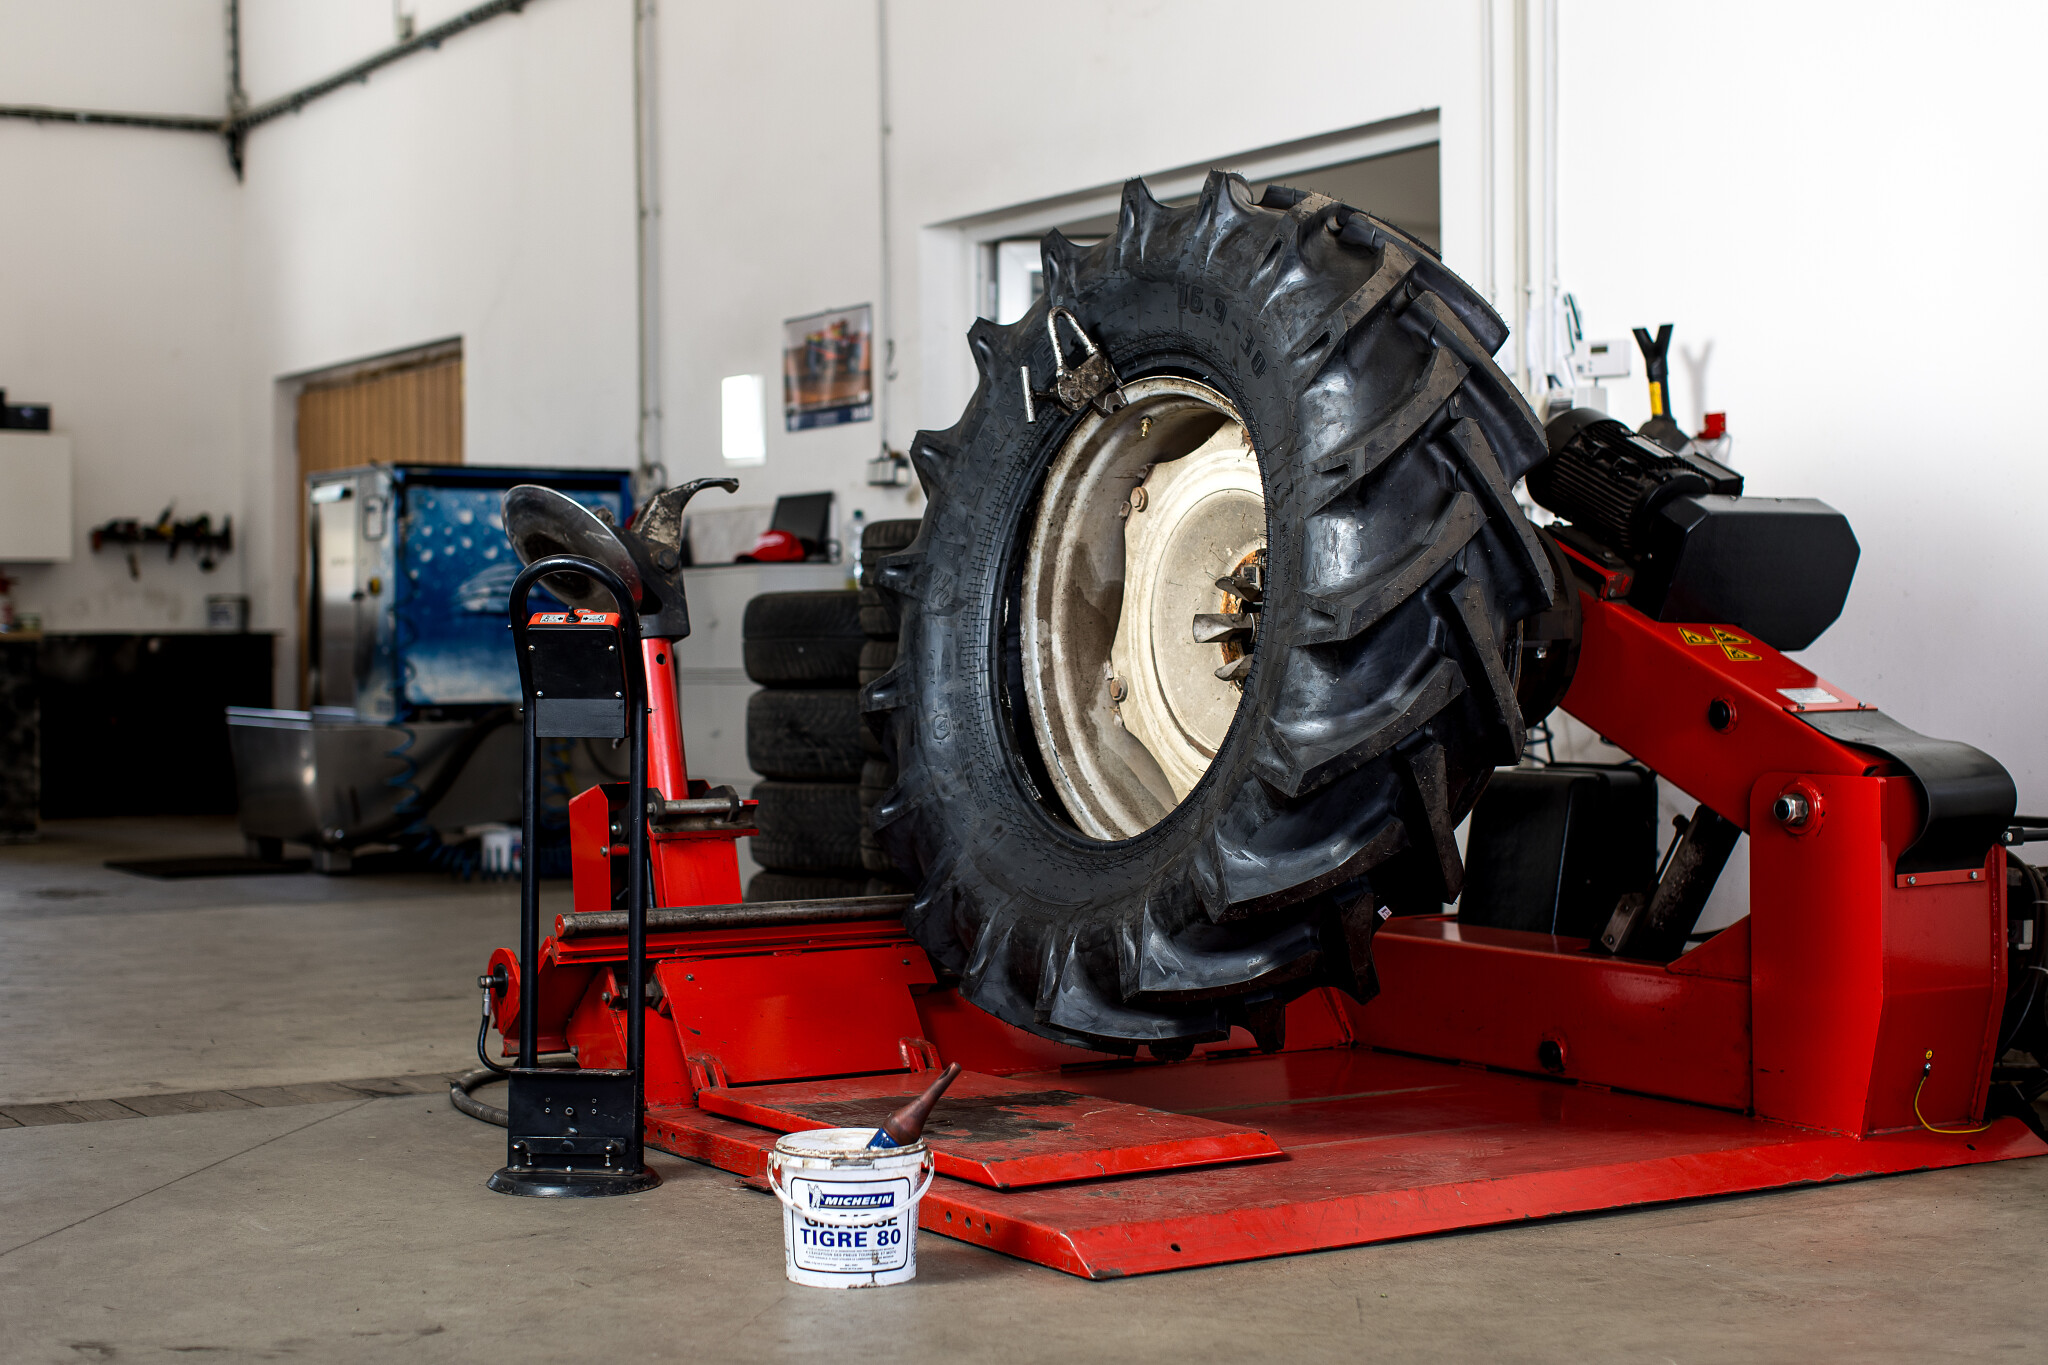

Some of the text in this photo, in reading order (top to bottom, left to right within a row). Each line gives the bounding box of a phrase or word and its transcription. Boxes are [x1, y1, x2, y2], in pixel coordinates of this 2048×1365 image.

[824, 1195, 892, 1206] MICHELIN
[800, 1227, 868, 1248] TIGRE
[876, 1228, 901, 1246] 80
